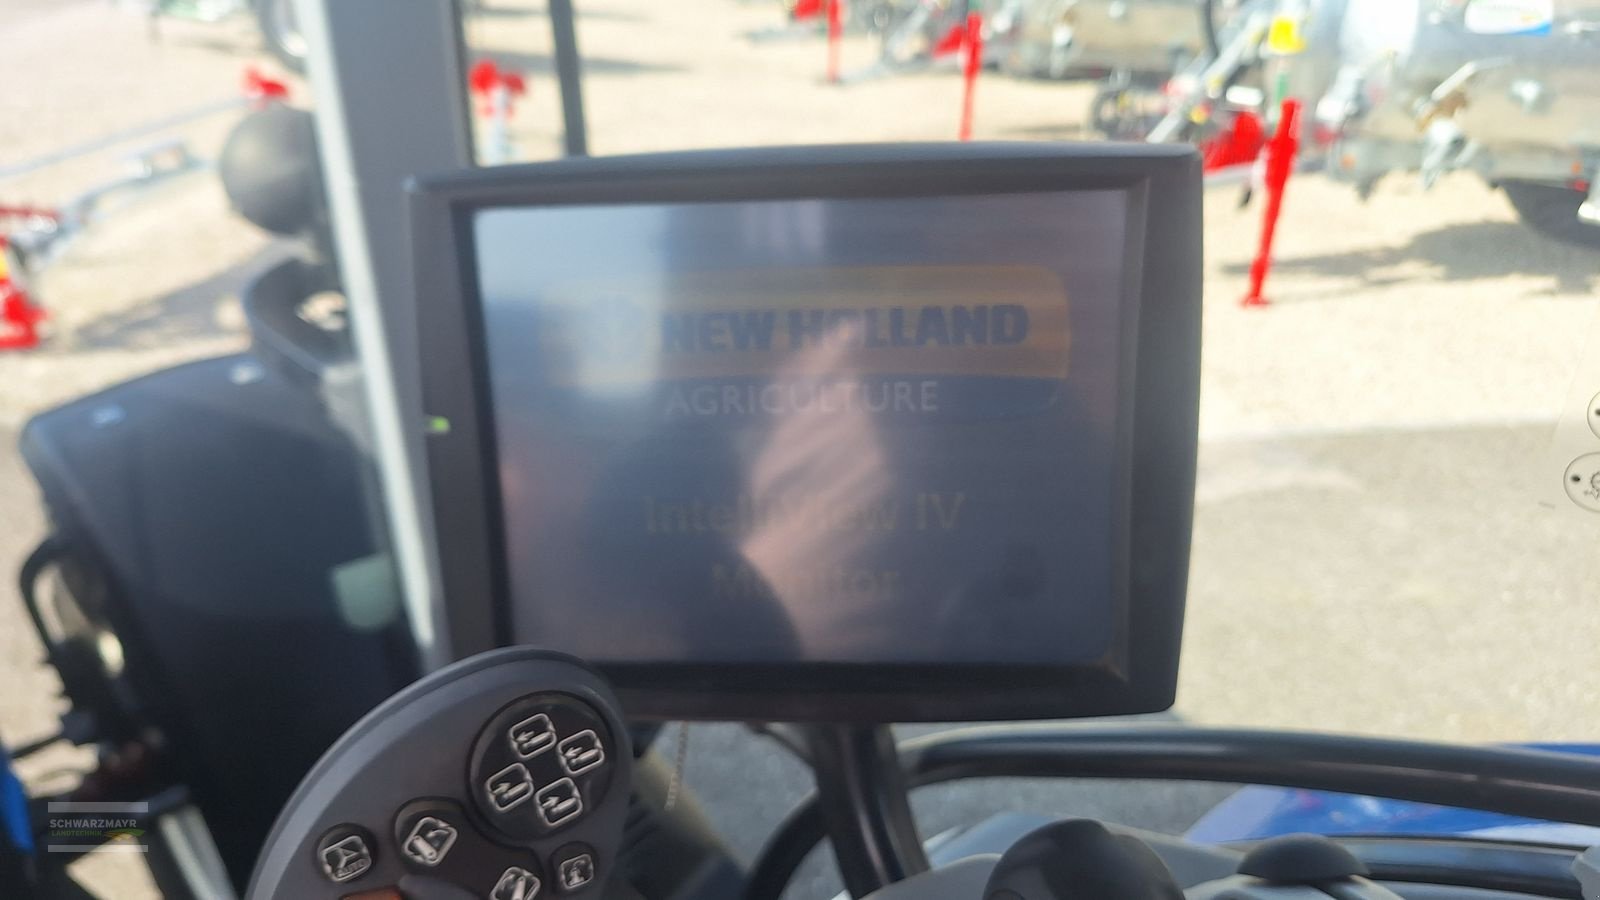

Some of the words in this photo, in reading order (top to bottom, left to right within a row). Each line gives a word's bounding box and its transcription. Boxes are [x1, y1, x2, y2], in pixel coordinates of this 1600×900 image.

[660, 310, 775, 353] NEW
[787, 303, 1031, 351] HOLLAND
[664, 379, 939, 416] AGRICULTURE
[915, 490, 966, 532] IV
[711, 561, 903, 601] Mnitor
